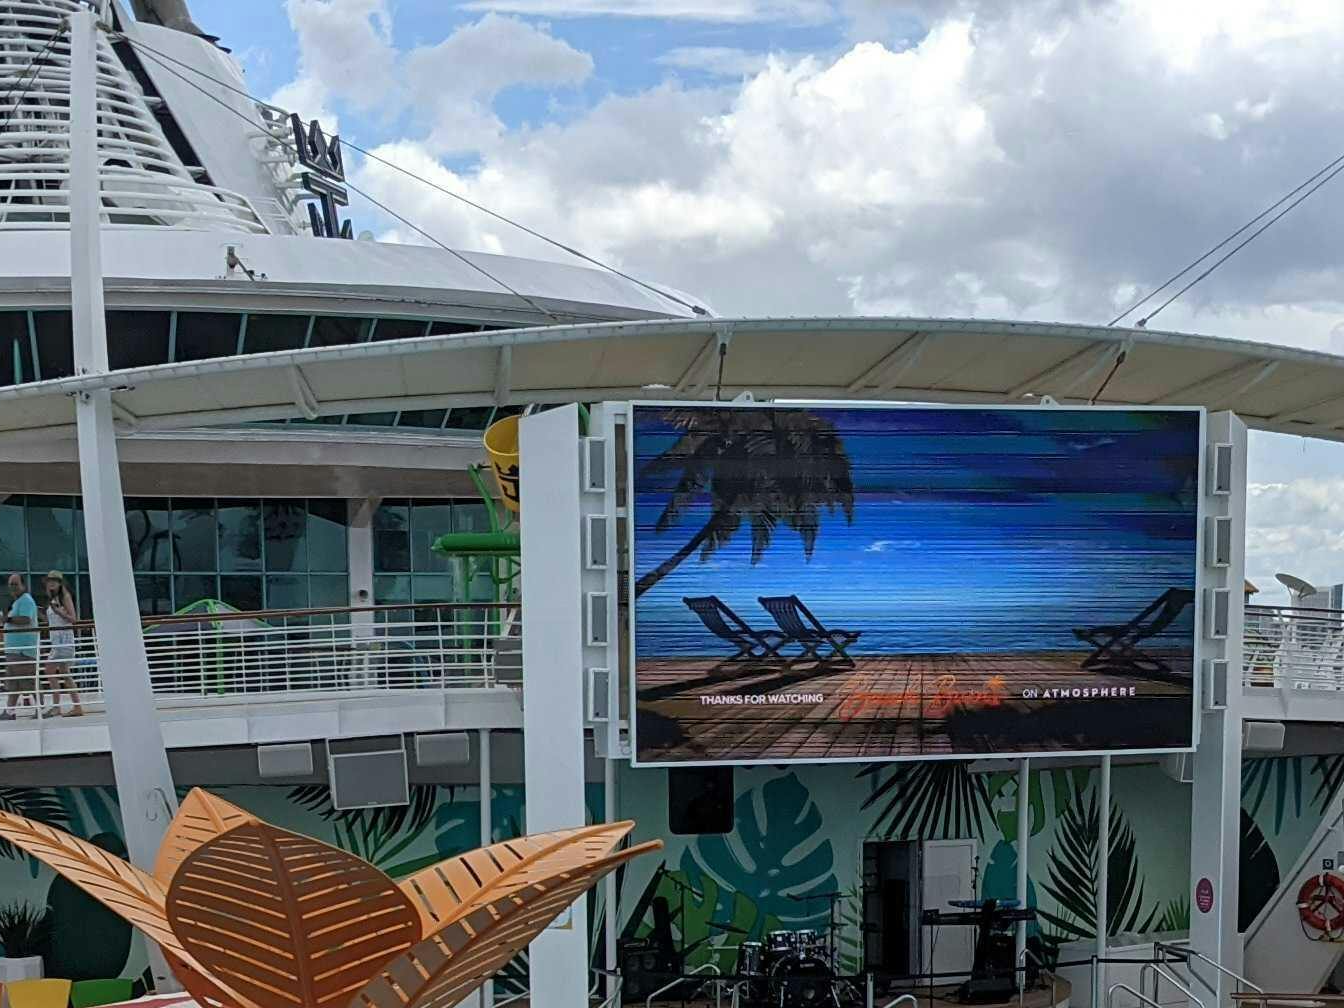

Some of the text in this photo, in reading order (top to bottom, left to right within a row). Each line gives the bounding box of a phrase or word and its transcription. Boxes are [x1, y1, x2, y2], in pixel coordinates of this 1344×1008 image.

[1022, 687, 1136, 698] ON ATMOSPHERE
[700, 693, 824, 705] THANKS FOR WATCHING
